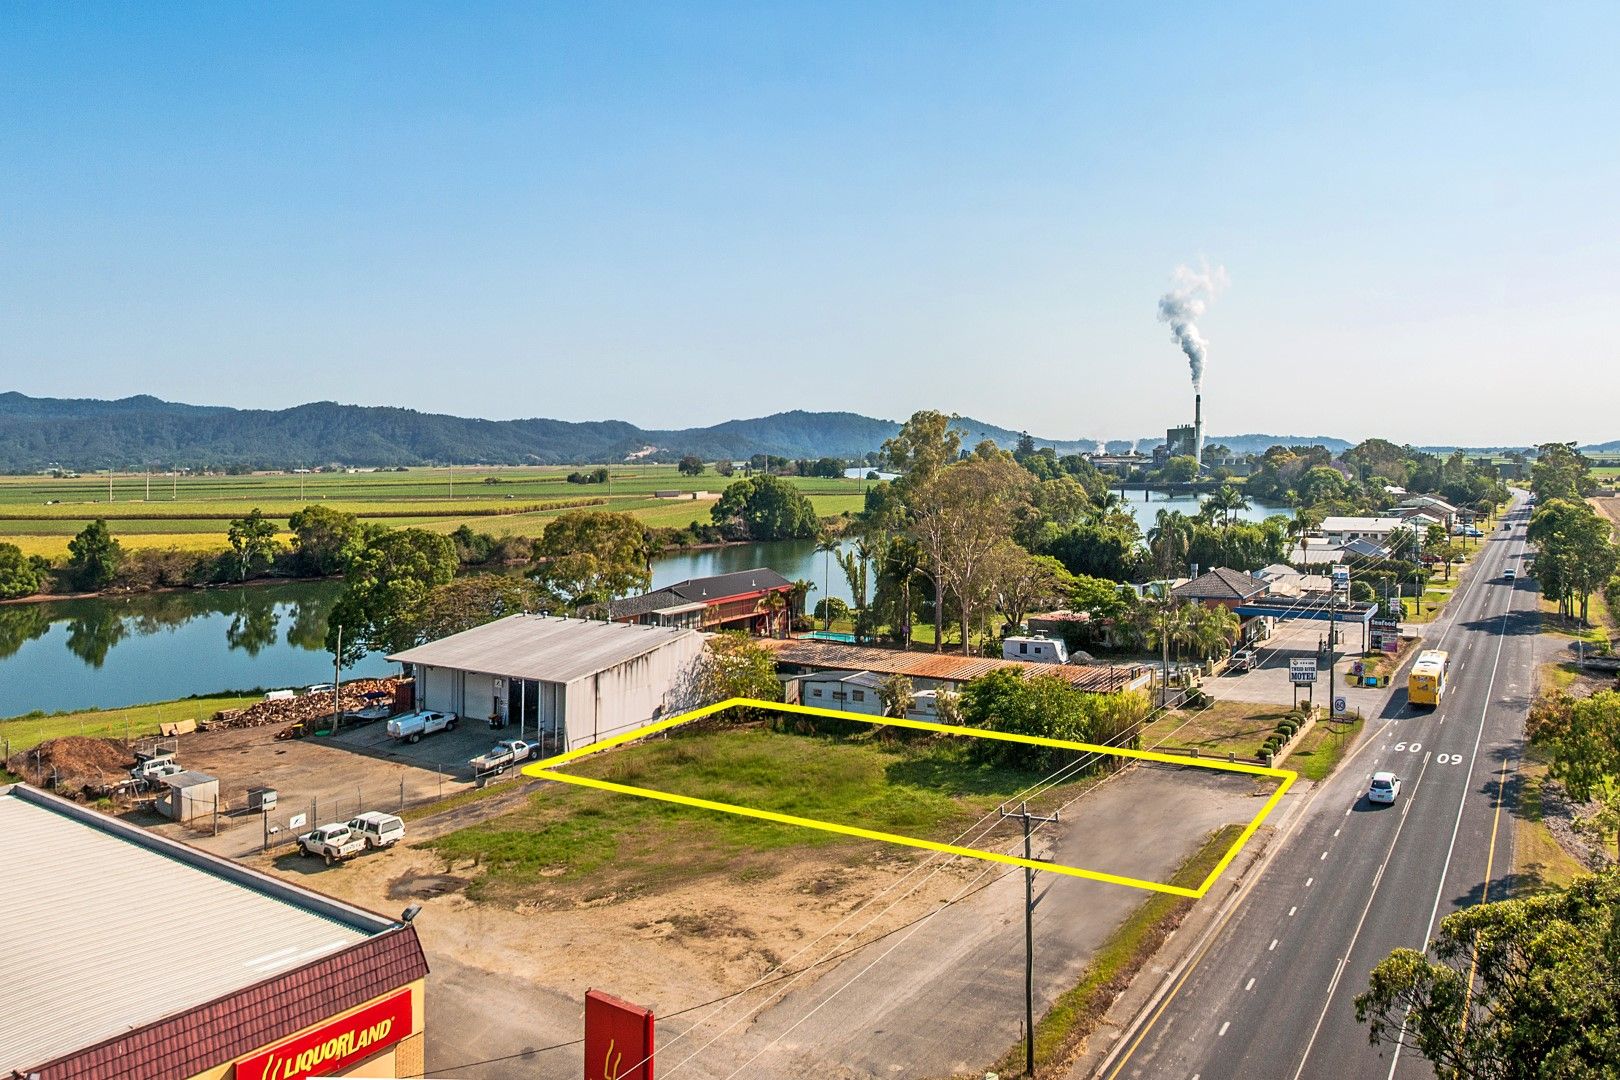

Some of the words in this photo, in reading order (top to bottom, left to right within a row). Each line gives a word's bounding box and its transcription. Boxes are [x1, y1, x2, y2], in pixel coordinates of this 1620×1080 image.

[1371, 619, 1396, 627] Seafood
[1291, 672, 1315, 680] MOTEL
[1394, 742, 1422, 753] 60
[283, 1019, 392, 1079] LIQUORLAND
